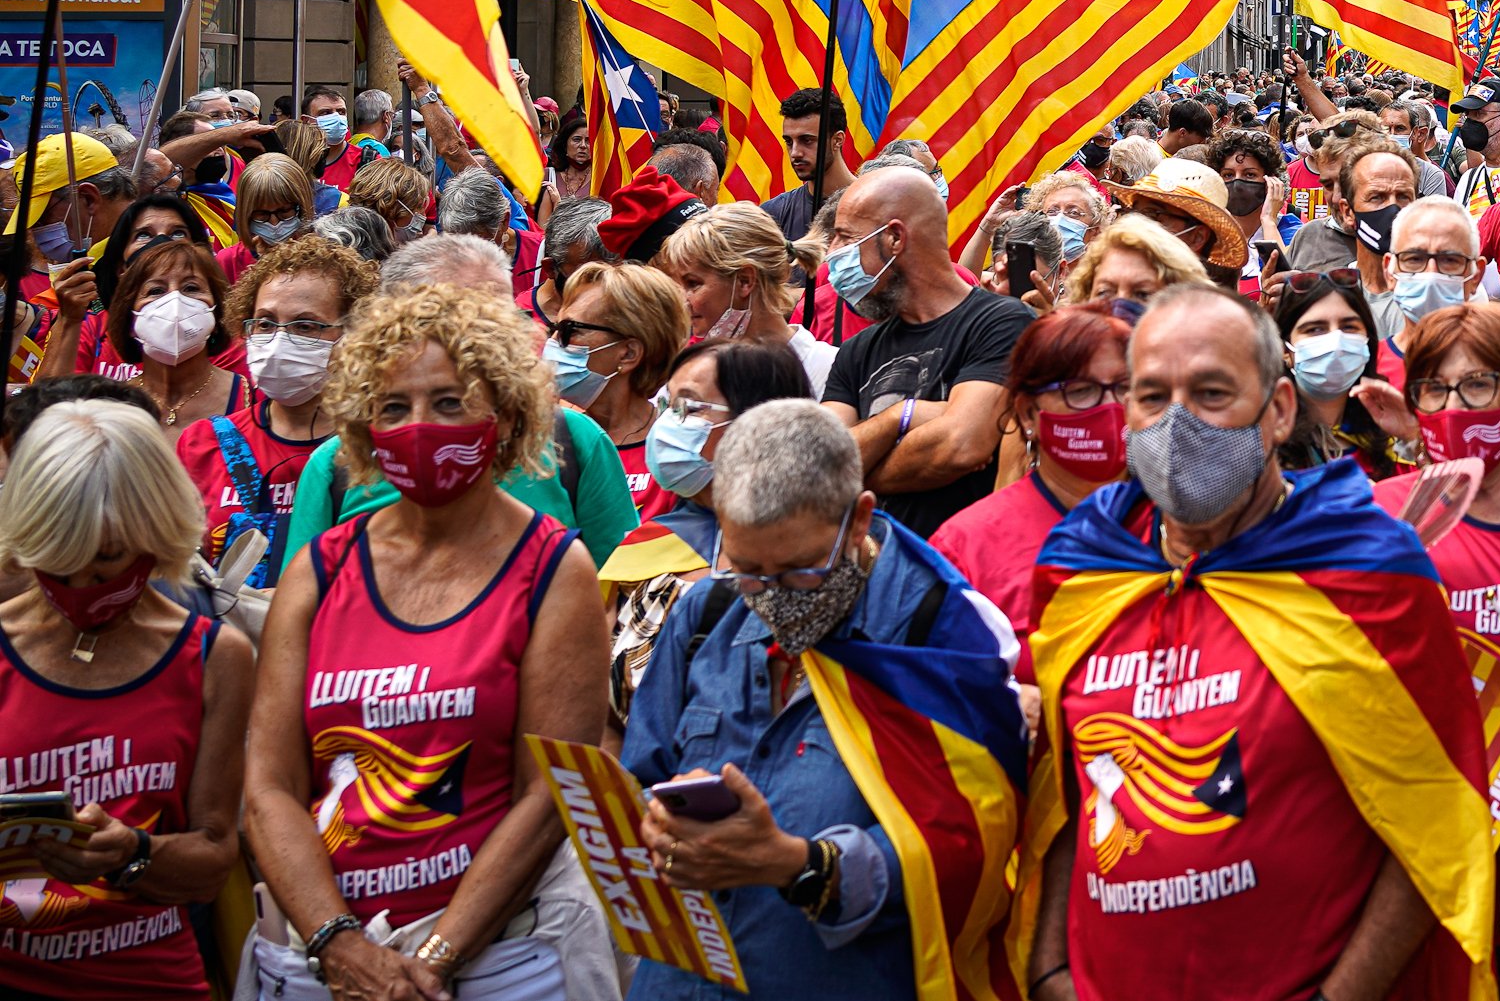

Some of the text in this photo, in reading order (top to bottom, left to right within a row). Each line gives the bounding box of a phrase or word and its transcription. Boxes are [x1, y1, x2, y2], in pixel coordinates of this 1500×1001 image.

[309, 664, 431, 709] LLUITEM I
[1188, 649, 1201, 680] I
[362, 686, 477, 730] GUANYEM
[1132, 669, 1242, 720] GUANYEM
[0, 735, 132, 794] LLUITEM I
[64, 762, 177, 807] GUANYEM
[551, 766, 653, 934] EXIGIM
[620, 846, 659, 880] LA
[1098, 859, 1257, 914] INDEPENDÈNCIA
[20, 906, 183, 961] INDEPENDÈNCIA
